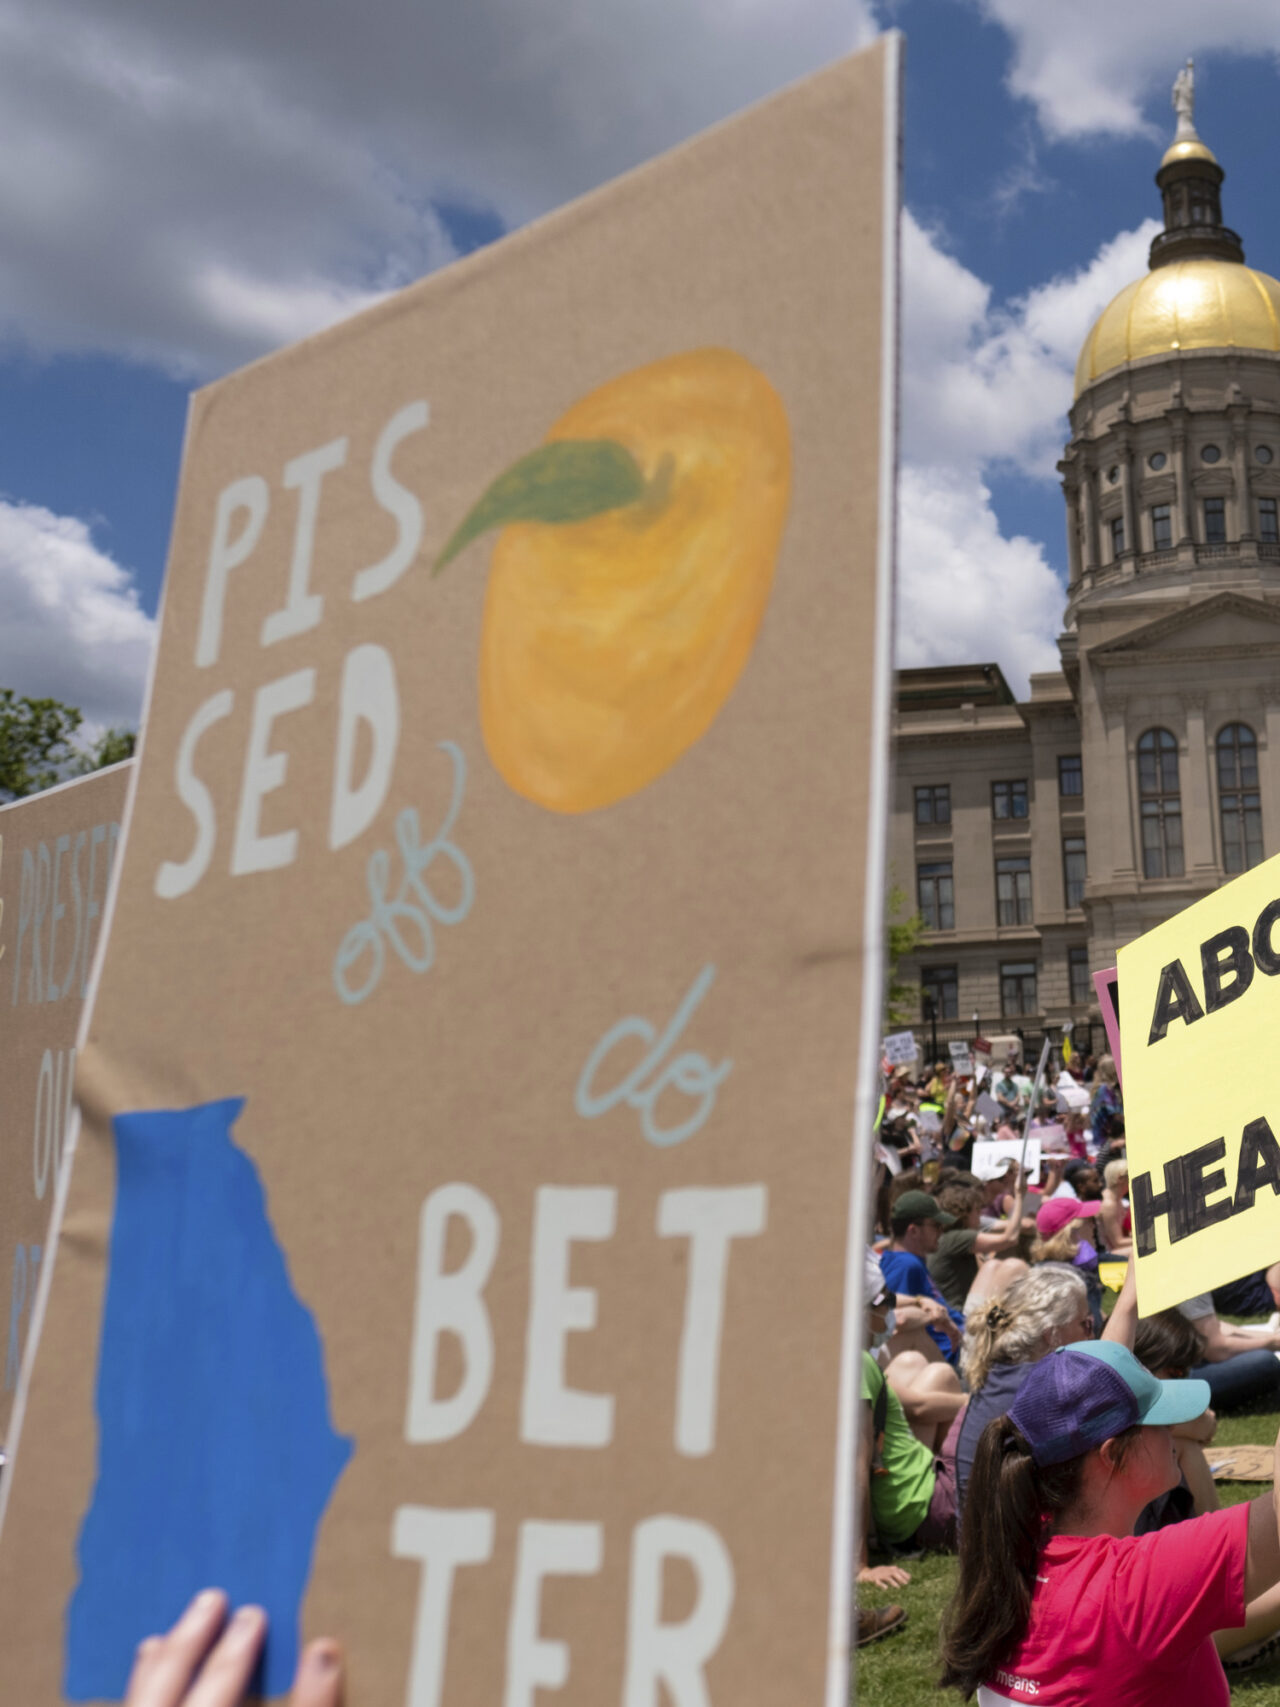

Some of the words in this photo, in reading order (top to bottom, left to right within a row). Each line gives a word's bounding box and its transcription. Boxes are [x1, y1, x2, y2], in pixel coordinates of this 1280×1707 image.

[154, 644, 400, 899] SED
[333, 740, 476, 1004] off
[575, 963, 733, 1147] do
[405, 1183, 768, 1457] BET
[390, 1504, 736, 1707] TER
[996, 1669, 1041, 1695] means:
